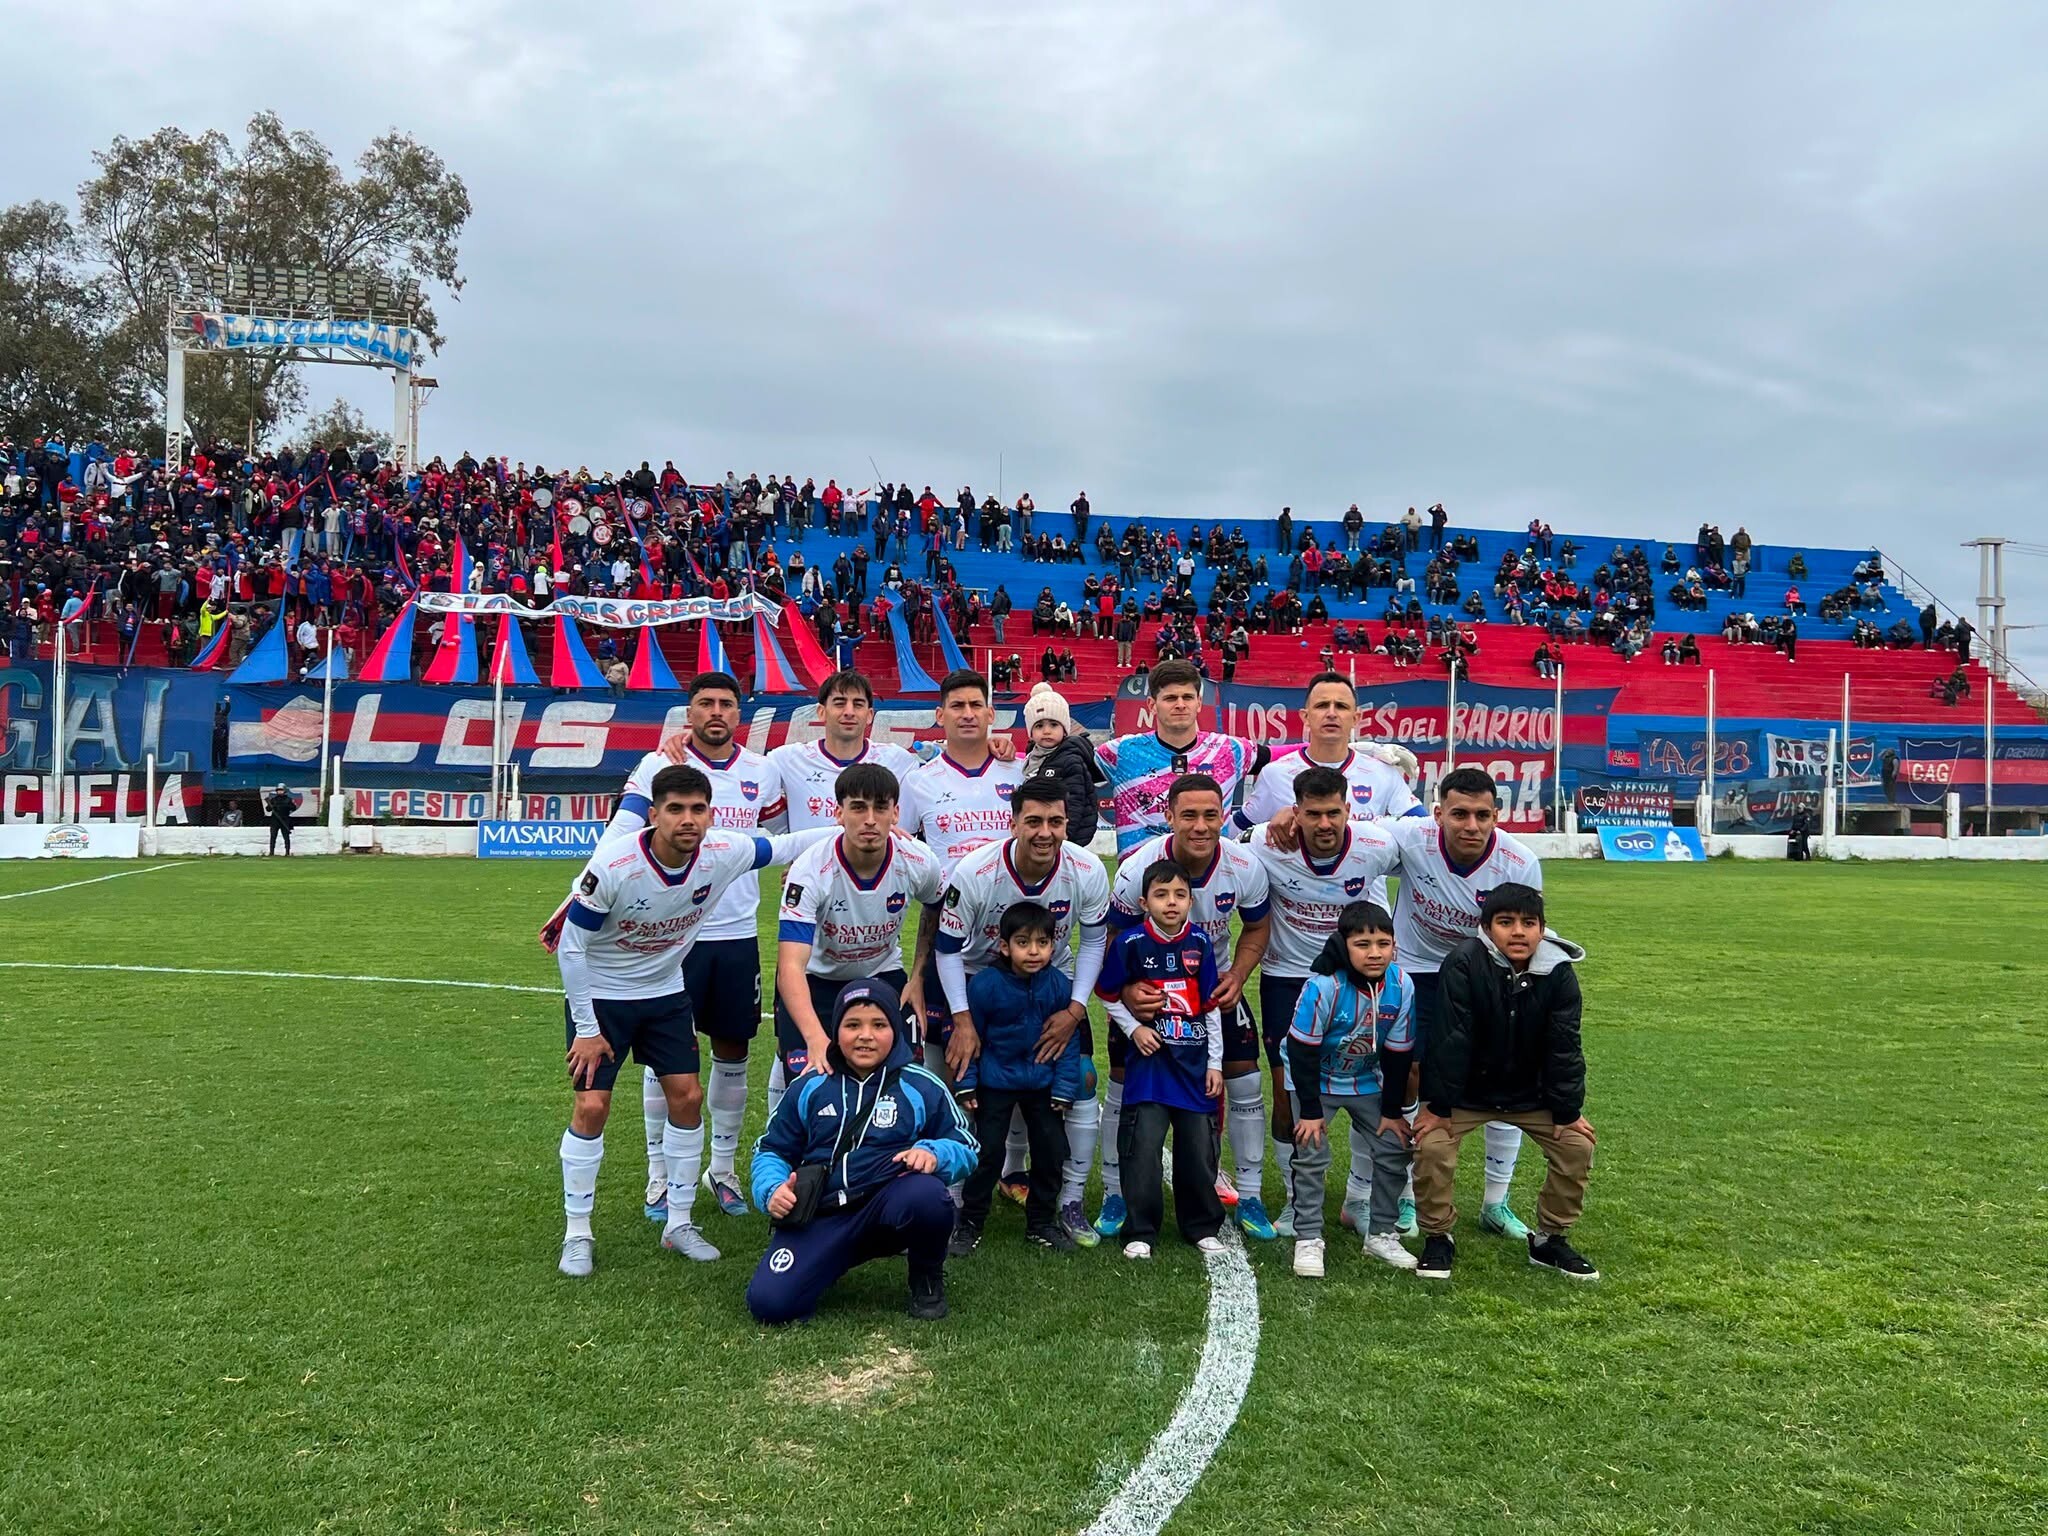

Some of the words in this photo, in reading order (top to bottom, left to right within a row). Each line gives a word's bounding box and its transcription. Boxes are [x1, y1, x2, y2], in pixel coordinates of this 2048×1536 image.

[342, 694, 617, 768] LOS
[1228, 702, 1288, 746] LOS
[1400, 716, 1442, 744] DEL
[1449, 701, 1559, 750] BARRIO
[355, 790, 485, 819] NECESITO
[712, 807, 757, 819] NTIAGO
[954, 809, 1011, 823] SANTIAG
[483, 825, 601, 844] MASARINA
[955, 823, 977, 832] DEL
[1297, 901, 1345, 912] SANTIA
[1427, 899, 1480, 922] SANTIAG
